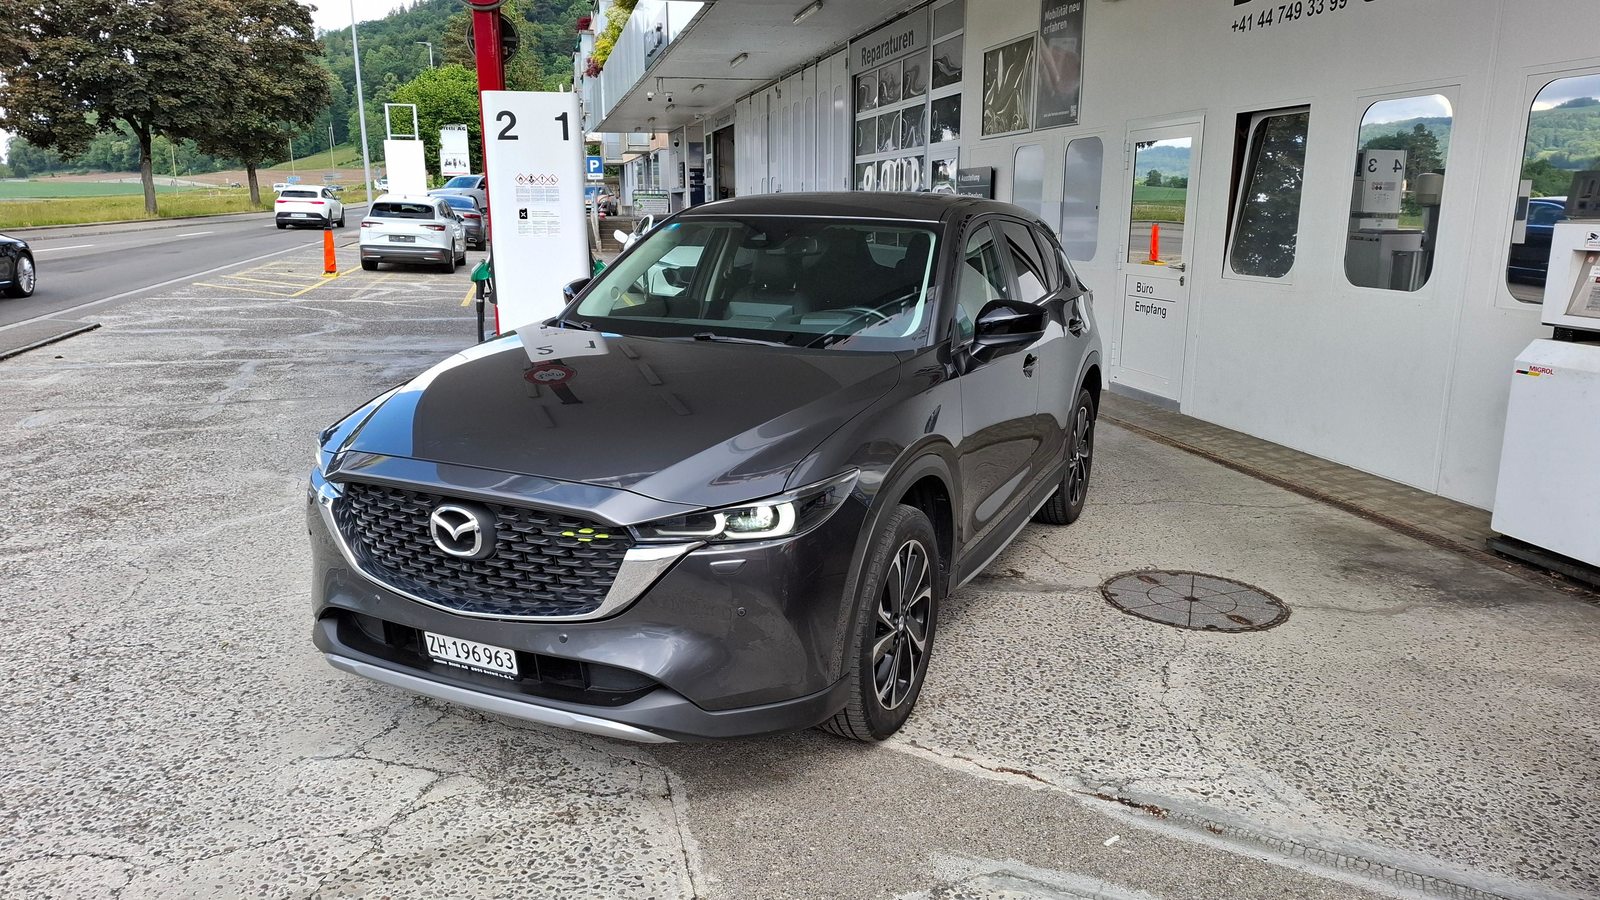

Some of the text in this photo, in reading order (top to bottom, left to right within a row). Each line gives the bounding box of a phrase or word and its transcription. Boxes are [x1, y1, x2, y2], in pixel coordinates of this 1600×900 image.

[1044, 2, 1081, 21] Mobilität neu
[1232, 13, 1253, 32] +41
[1257, 8, 1273, 28] 44
[1278, 1, 1303, 24] 749
[1307, 0, 1324, 16] 33
[1044, 20, 1067, 34] erfahren
[861, 30, 914, 66] Reparaturen
[496, 110, 569, 140] 2 1
[589, 159, 600, 173] P
[1136, 281, 1154, 294] Büro
[1134, 301, 1167, 319] Empfang
[1529, 365, 1554, 375] MIGROL
